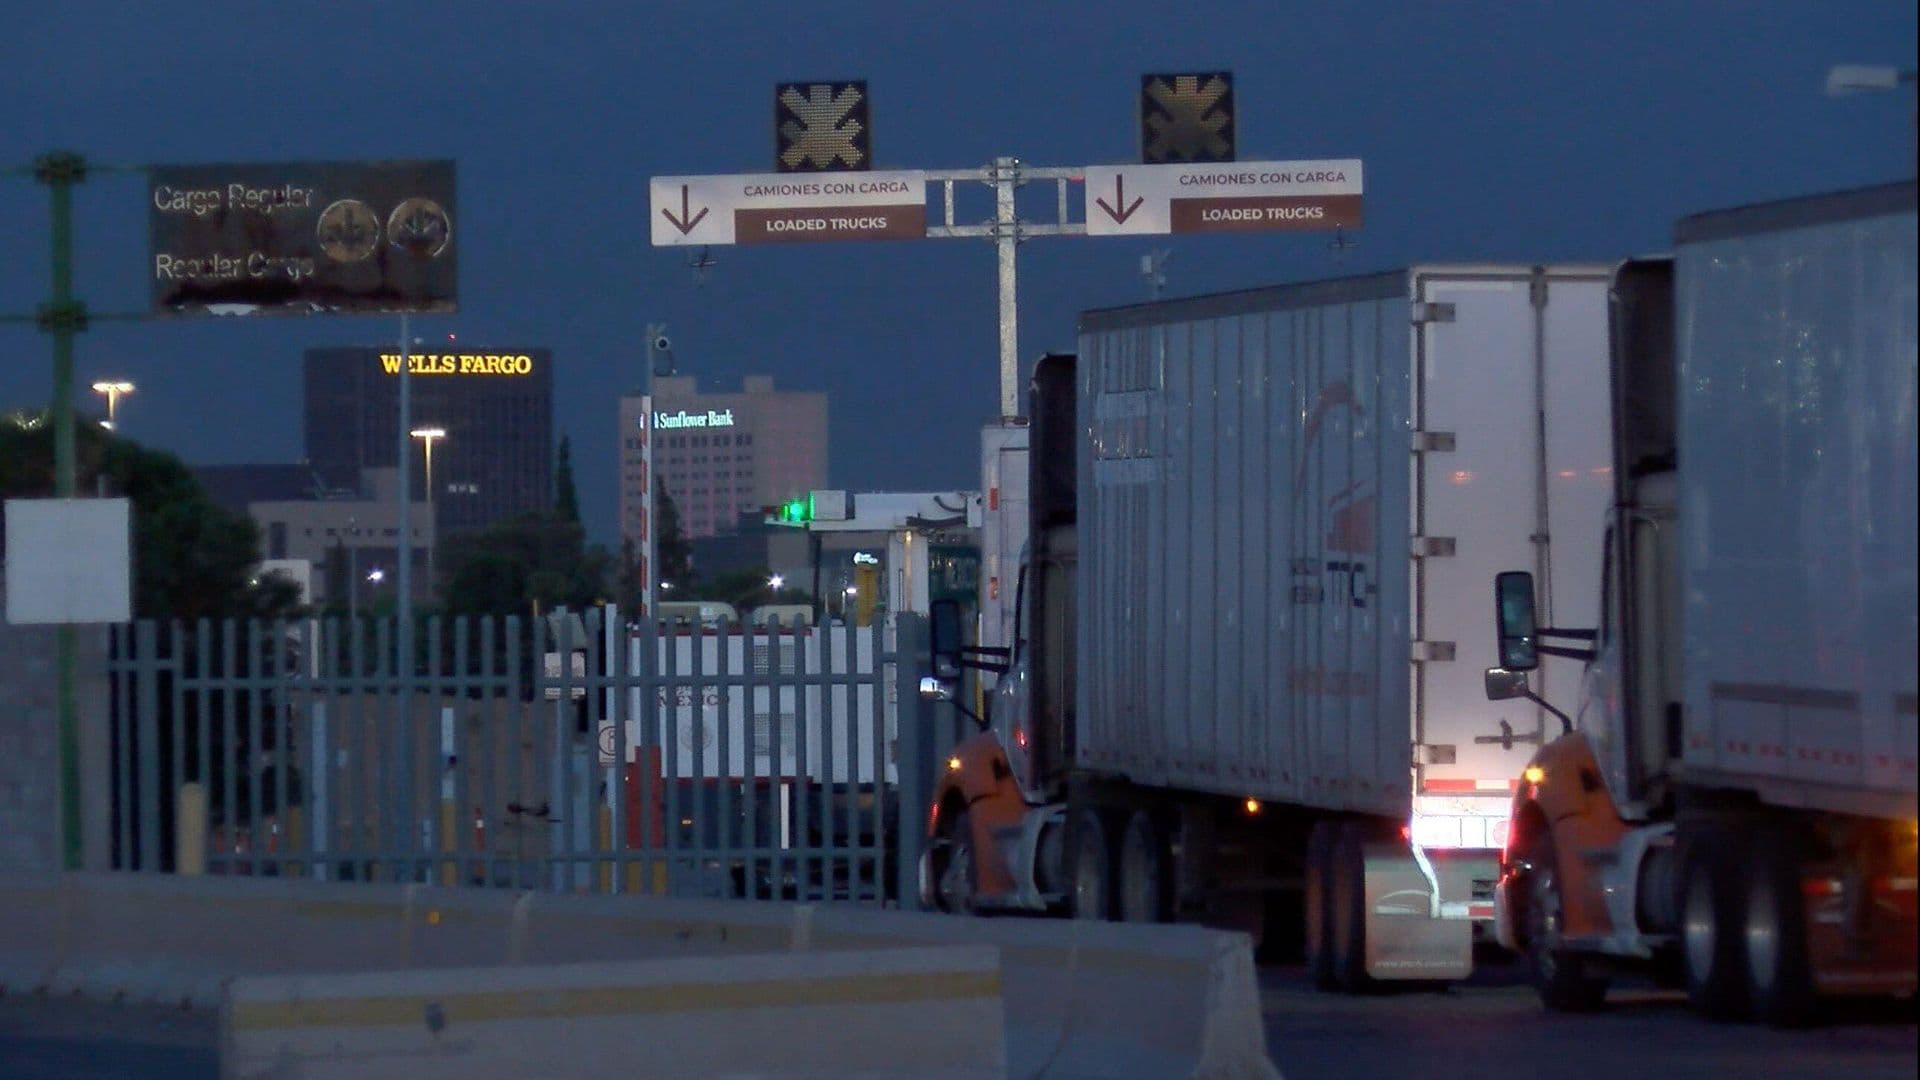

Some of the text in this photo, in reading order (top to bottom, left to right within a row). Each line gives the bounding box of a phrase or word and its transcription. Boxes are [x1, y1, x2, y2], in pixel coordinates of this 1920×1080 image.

[1180, 171, 1346, 186] CAMIONES CON CARGA
[743, 181, 909, 197] CAMIONES CON CARGA
[154, 185, 220, 215] Cargo
[1202, 206, 1323, 221] LOADED TRUCKS
[766, 217, 887, 232] LOADED TRUCKS
[380, 355, 533, 375] WELLS FARGO
[660, 410, 734, 428] Sunflower Bank
